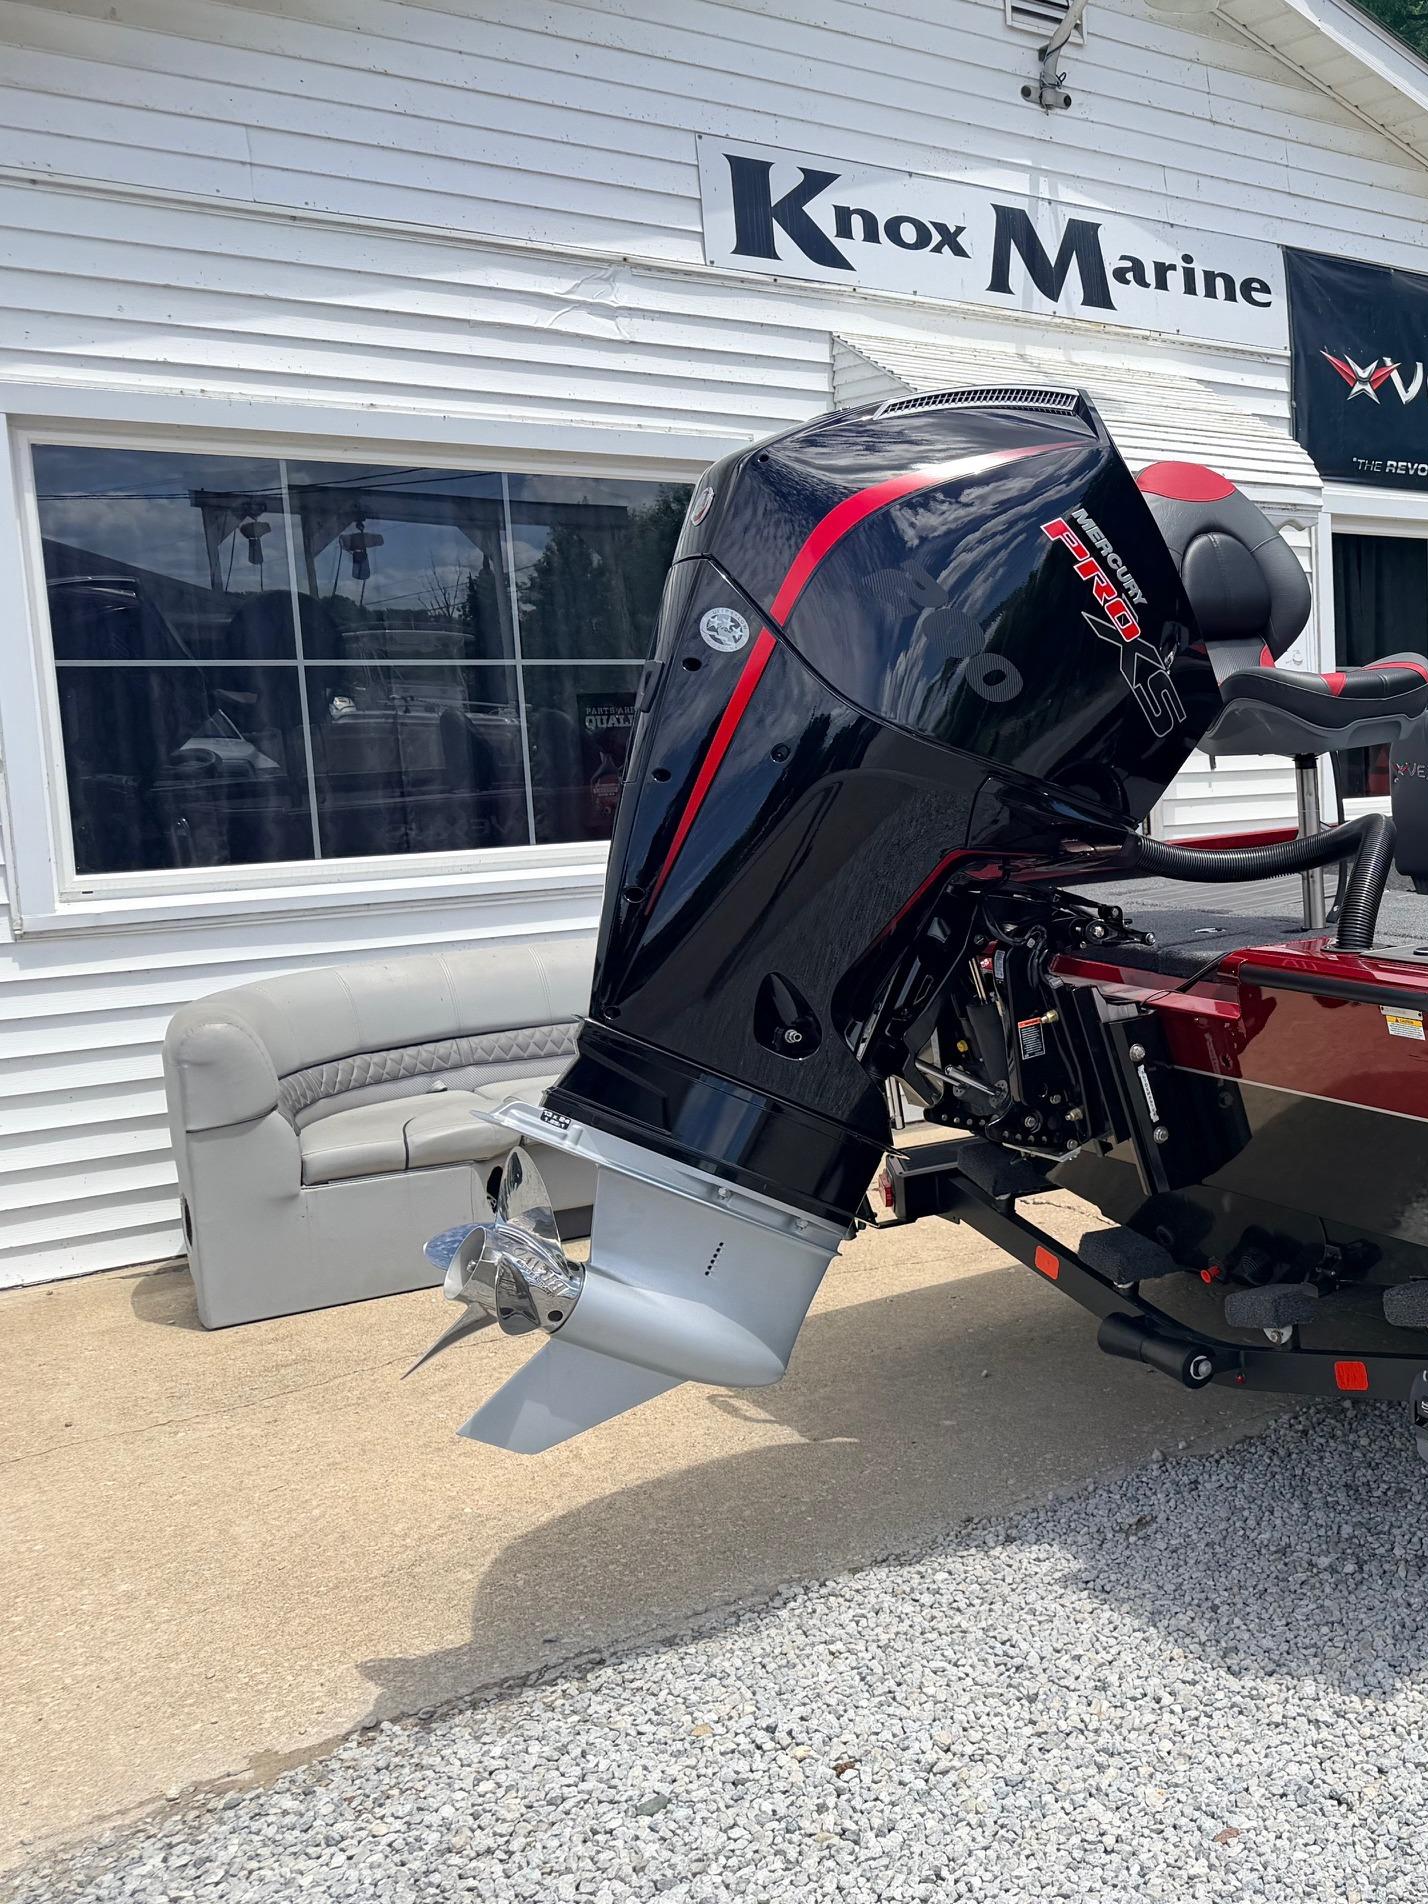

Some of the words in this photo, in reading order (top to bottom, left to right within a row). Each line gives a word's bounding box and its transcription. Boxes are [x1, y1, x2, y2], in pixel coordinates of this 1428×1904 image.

[721, 153, 972, 271] Knox
[985, 202, 1272, 311] Marine
[1040, 517, 1141, 643] PRO
[1072, 507, 1148, 605] MERCURY
[1081, 593, 1187, 738] XS
